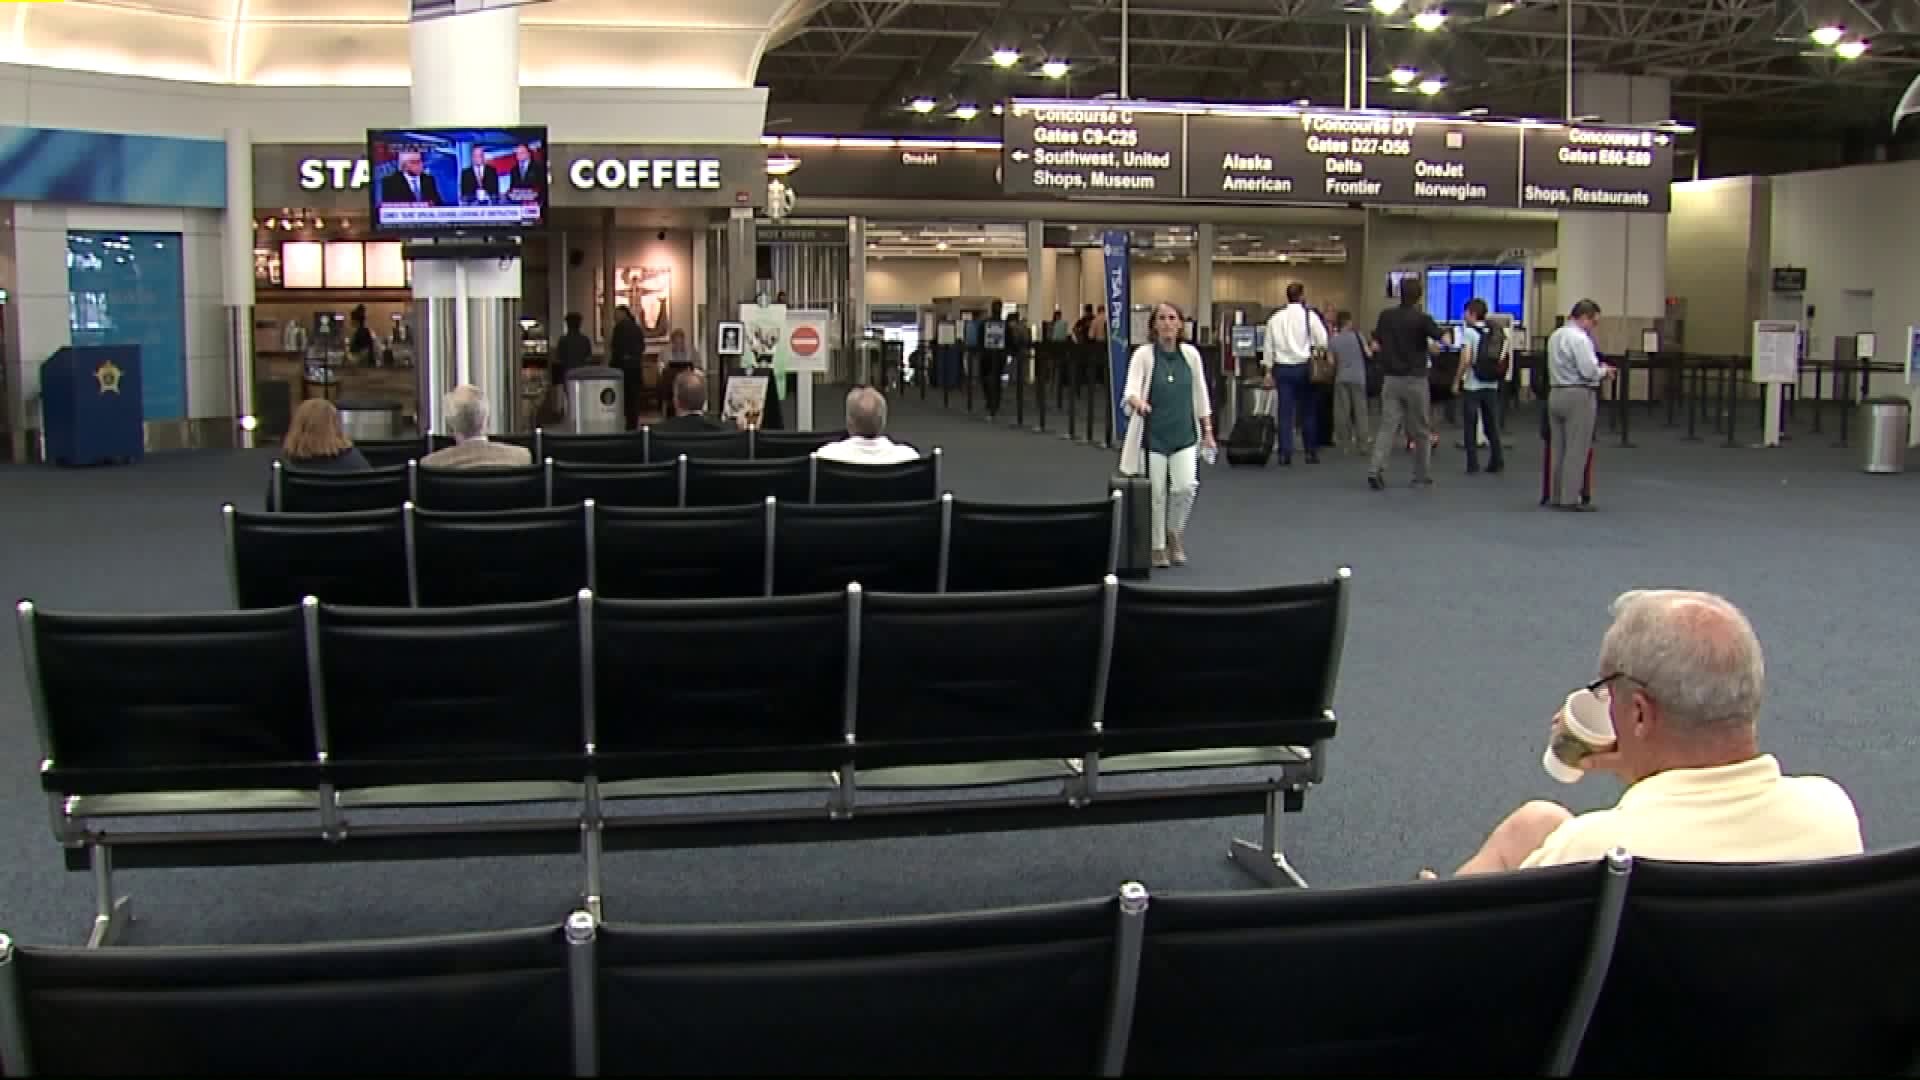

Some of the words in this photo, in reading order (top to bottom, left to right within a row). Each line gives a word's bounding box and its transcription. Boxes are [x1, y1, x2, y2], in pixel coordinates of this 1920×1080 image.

[1034, 107, 1117, 124] Concourse
[1121, 109, 1133, 125] C
[1313, 117, 1389, 134] Concourse
[1391, 118, 1402, 134] D
[1034, 126, 1079, 144] Gates
[1082, 127, 1138, 146] C9-C25
[1306, 135, 1348, 153] Gates
[1351, 138, 1411, 155] D27-D56
[1568, 128, 1640, 145] Concourse
[1641, 131, 1652, 147] E
[1034, 148, 1120, 168] Southwest,
[1123, 151, 1170, 168] United
[1223, 153, 1273, 171] Alaska
[1325, 157, 1363, 173] Delta
[1558, 147, 1597, 164] Gates
[569, 158, 721, 189] COFFEE
[1414, 160, 1464, 178] OneJet
[1034, 169, 1087, 190] Shops,
[1090, 171, 1155, 189] Museum
[1223, 175, 1292, 192] American
[1325, 177, 1382, 195] Frontier
[1414, 182, 1486, 201] Norwegian
[1524, 184, 1570, 204] Shops,
[1573, 187, 1649, 207] Restaurants
[1111, 266, 1123, 299] TSA
